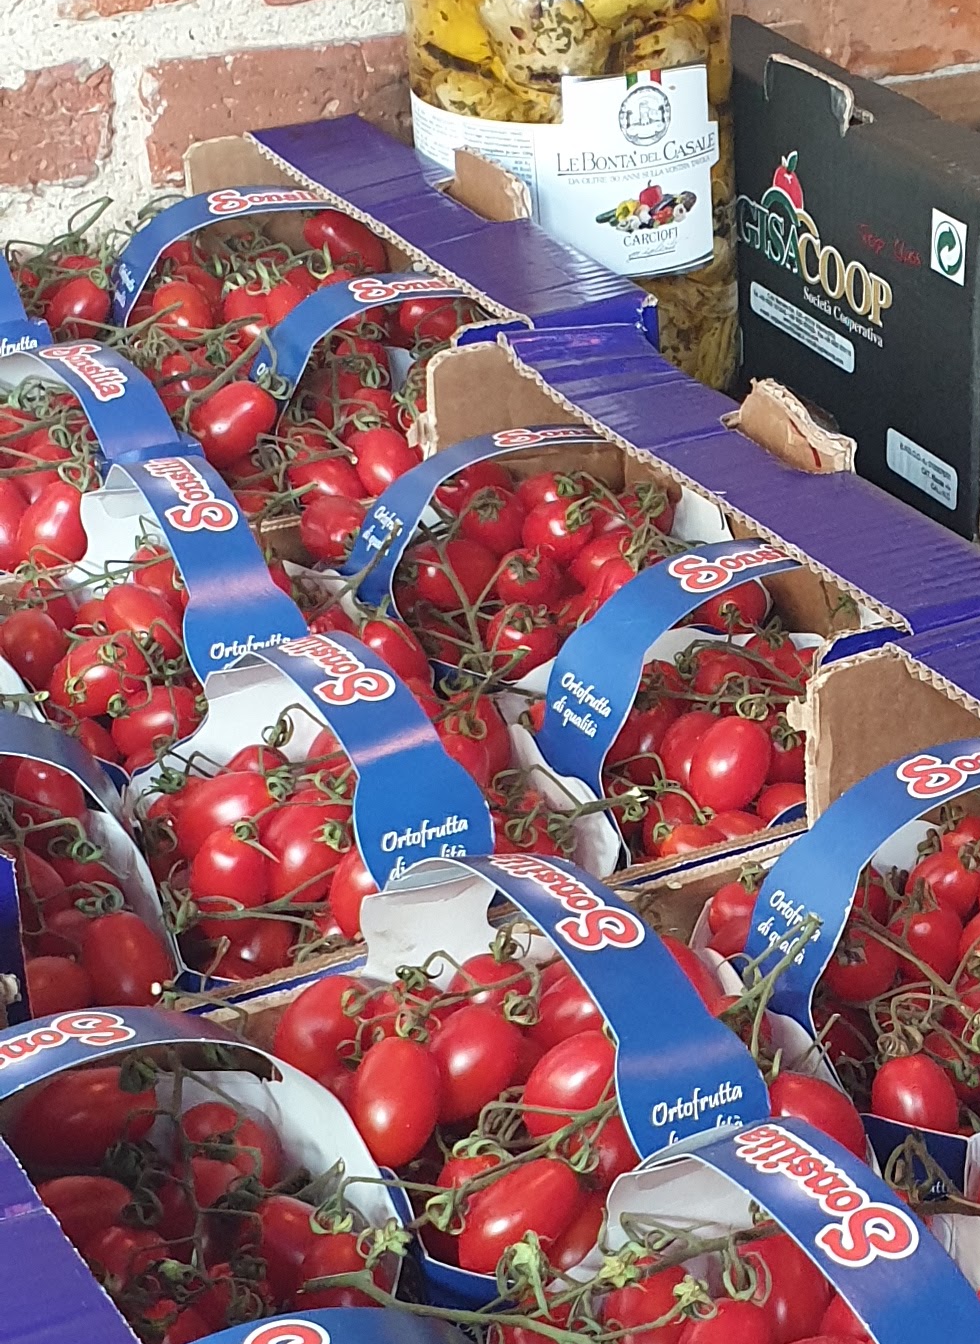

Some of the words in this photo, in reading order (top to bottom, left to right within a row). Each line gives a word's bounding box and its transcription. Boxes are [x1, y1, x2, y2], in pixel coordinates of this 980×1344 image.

[640, 152, 663, 164] DEL
[664, 132, 716, 159] CASALE
[623, 226, 679, 248] CARCIOFI
[736, 194, 894, 328] GISACOOP
[803, 285, 832, 317] Società
[833, 301, 884, 349] Cooperativa
[552, 695, 568, 714] di
[562, 708, 598, 738] qualità
[561, 671, 612, 718] Ortofrutta
[381, 815, 469, 853] Ortofrutta
[757, 916, 775, 937] di
[652, 1081, 744, 1127] Ortofrutta
[734, 1123, 920, 1268] Sonsilia
